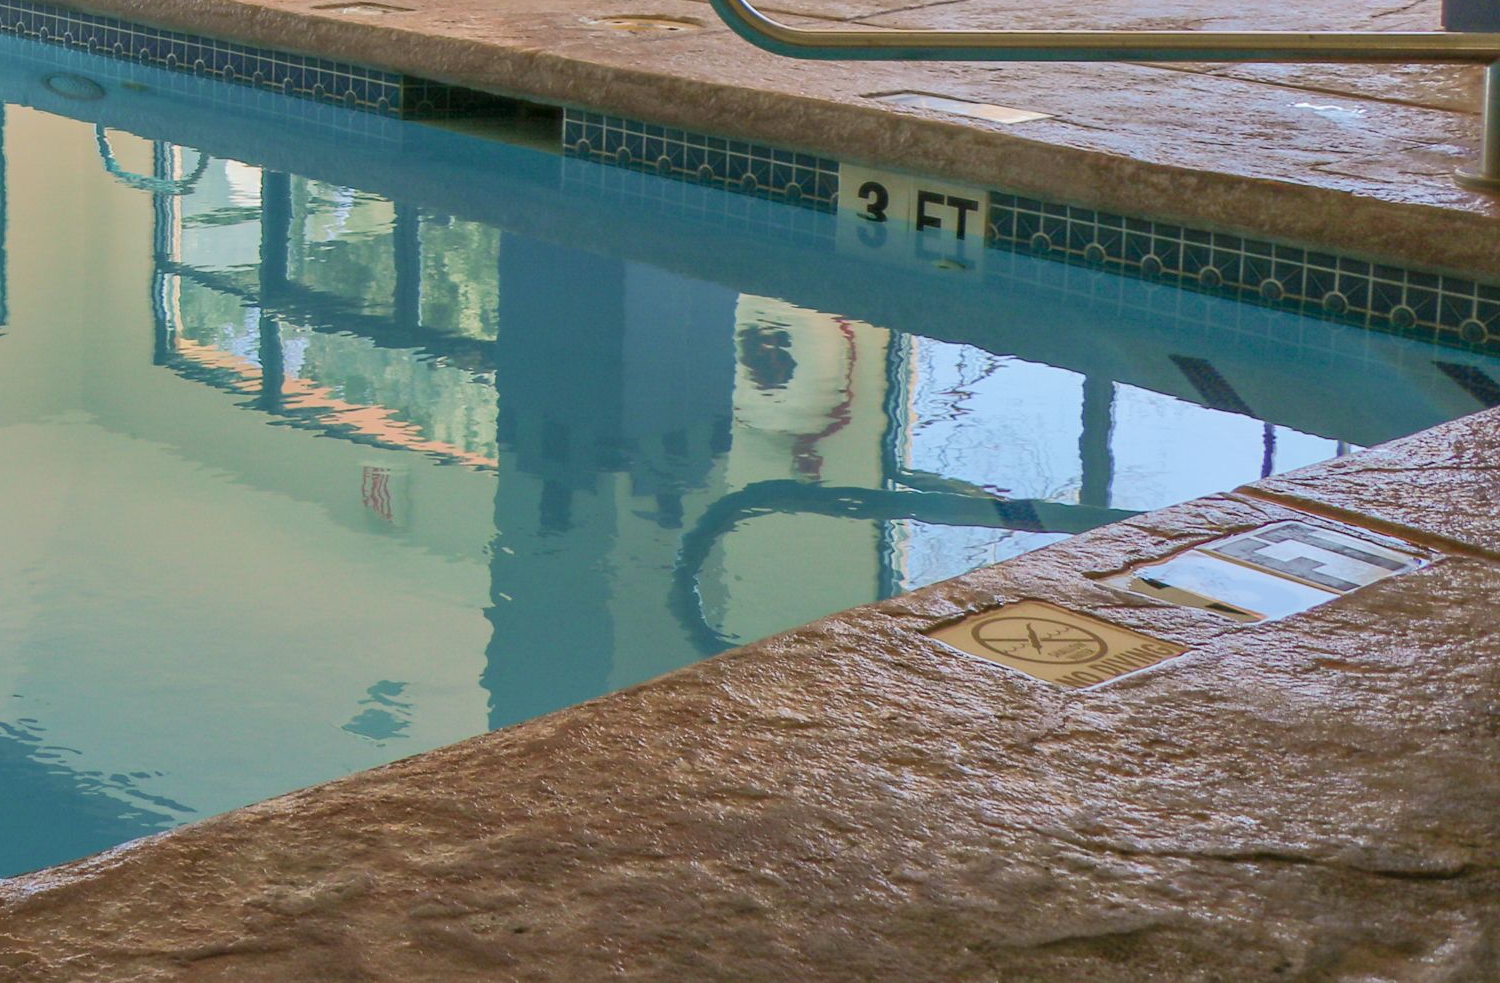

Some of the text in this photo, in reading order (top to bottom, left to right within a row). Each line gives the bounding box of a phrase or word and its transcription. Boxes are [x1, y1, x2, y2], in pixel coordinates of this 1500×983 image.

[857, 181, 979, 241] 3 FT
[1055, 670, 1104, 688] NO
[1087, 642, 1175, 676] DIVING
